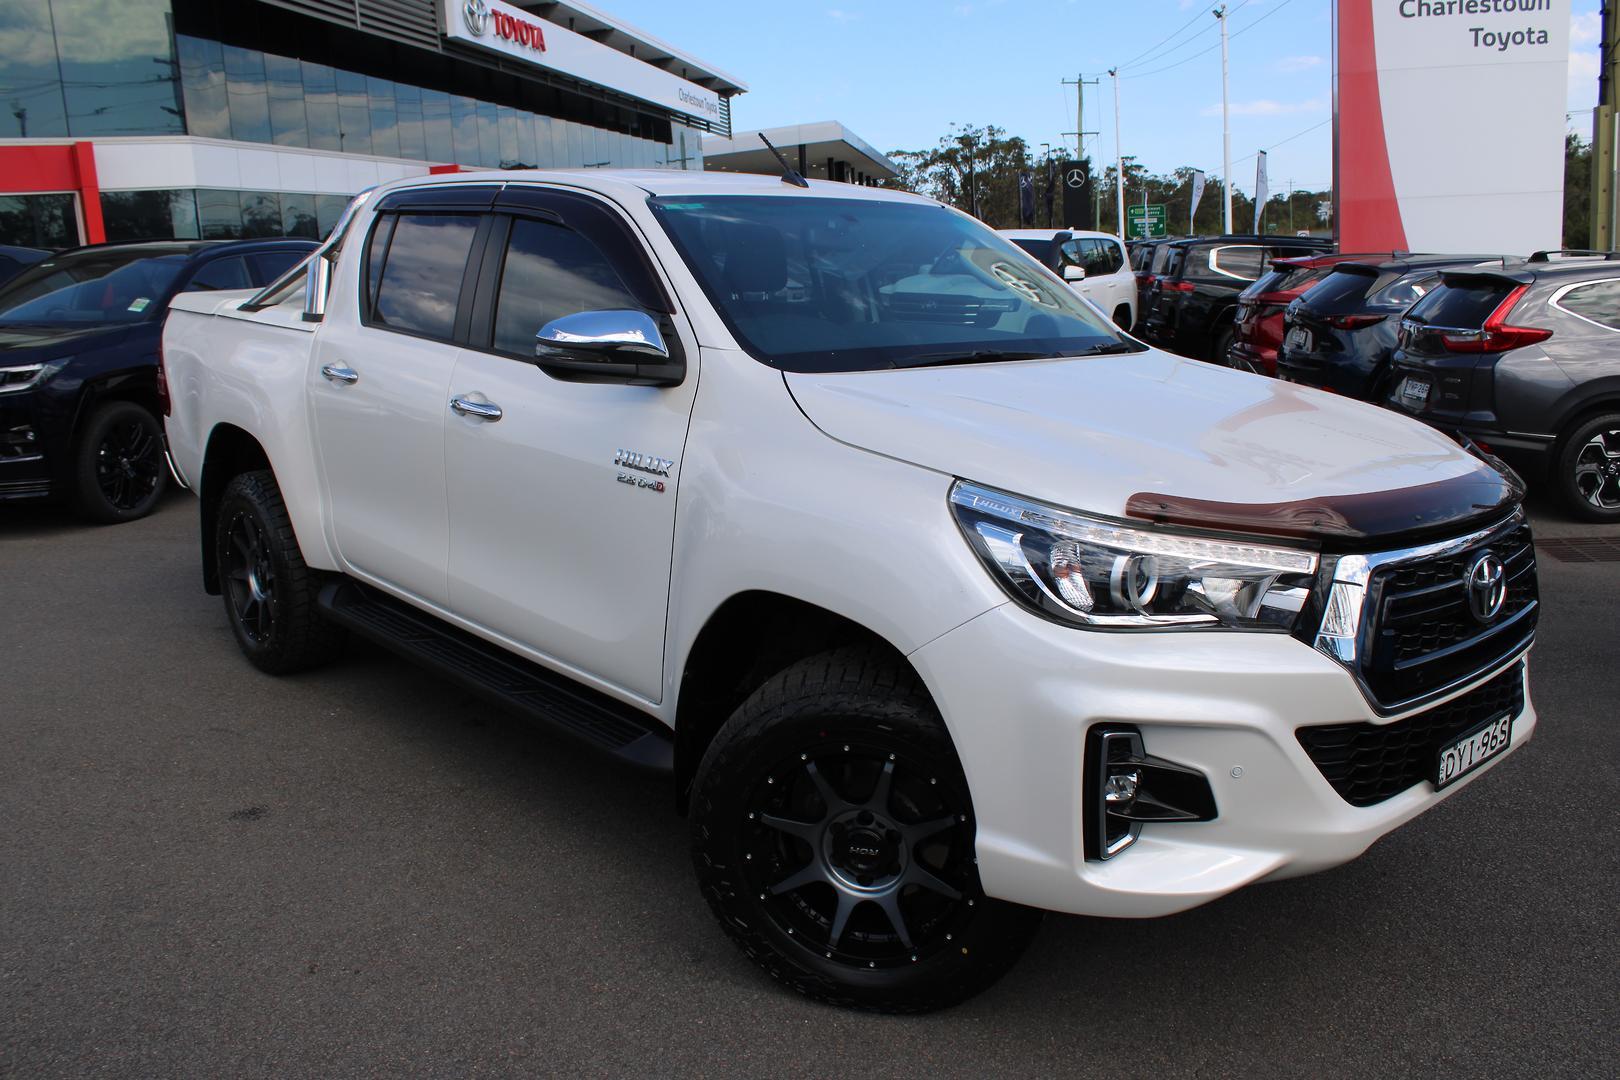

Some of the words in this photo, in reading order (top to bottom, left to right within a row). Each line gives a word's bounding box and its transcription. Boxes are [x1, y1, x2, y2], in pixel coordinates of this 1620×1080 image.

[1399, 0, 1551, 18] Charlestown
[491, 8, 546, 52] TOYOTA
[1469, 27, 1549, 51] Toyota
[614, 448, 674, 478] HILUX
